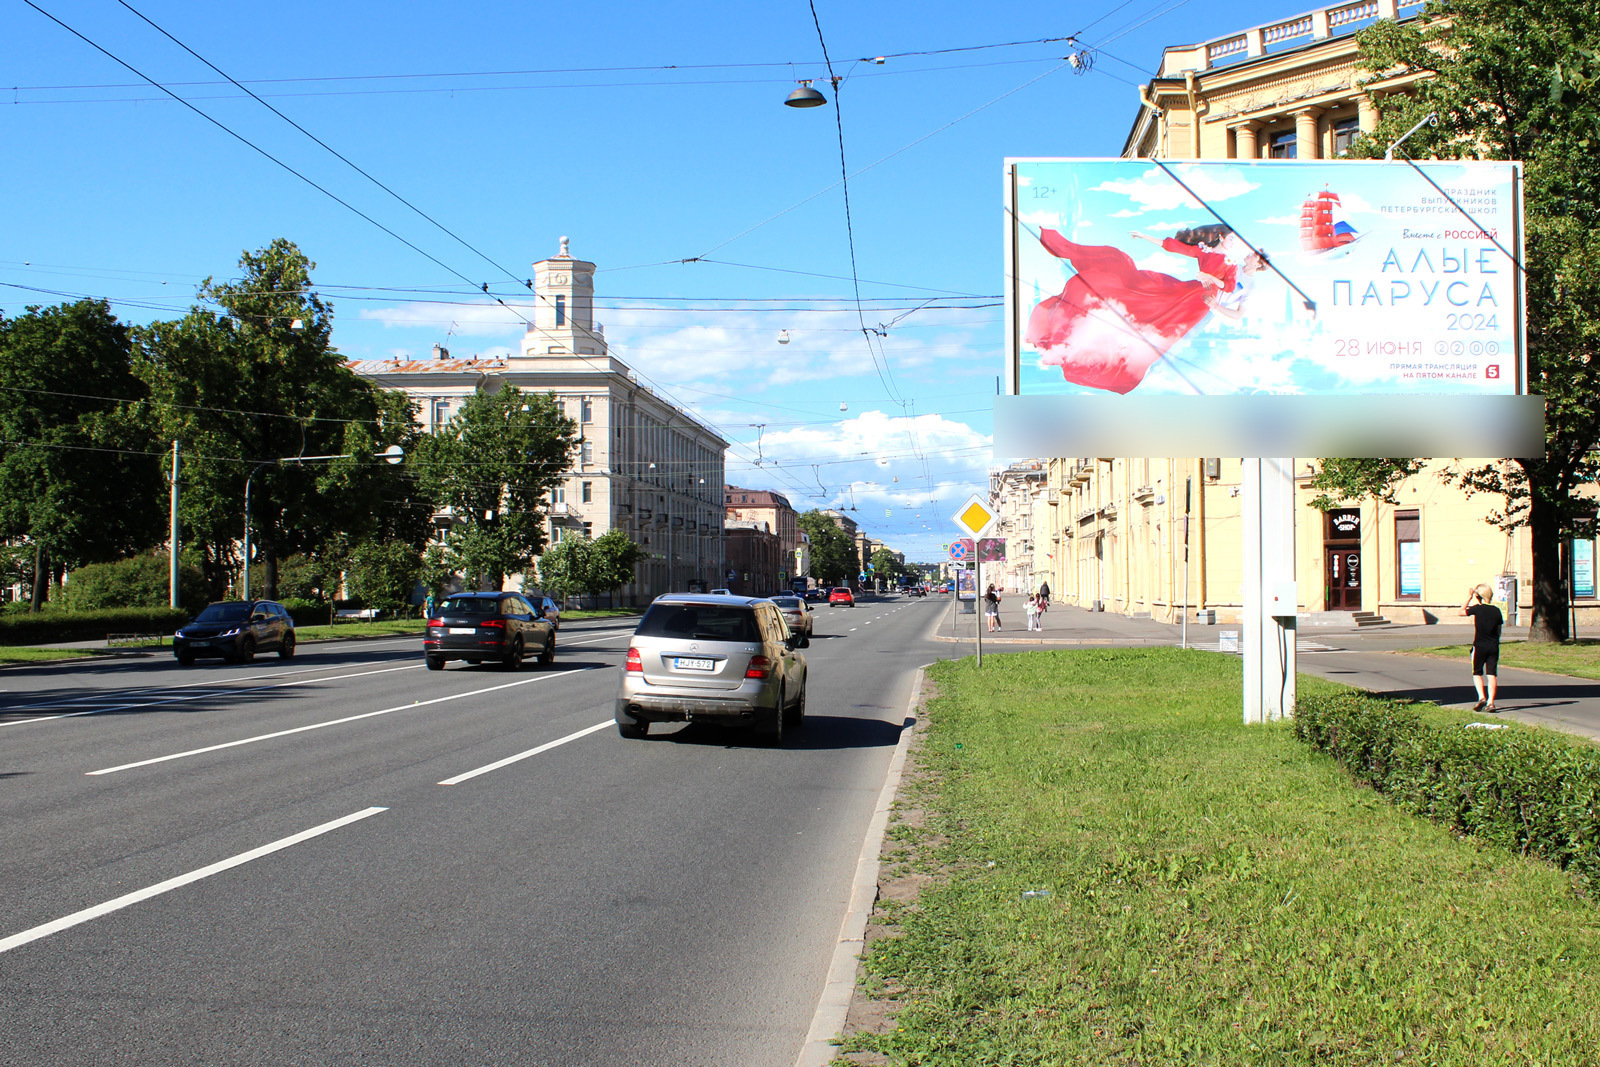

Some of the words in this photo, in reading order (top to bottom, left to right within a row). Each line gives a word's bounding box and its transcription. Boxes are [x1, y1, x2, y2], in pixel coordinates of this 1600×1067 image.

[1032, 186, 1057, 199] 12+
[1444, 188, 1497, 196] ПРАЗДНИК
[1421, 197, 1497, 205] ВЫПУКНИКОВ
[1403, 228, 1434, 239] Вместе
[1444, 228, 1498, 240] РОССИЕЙ
[1382, 247, 1498, 274] АЛЫЕ
[1333, 280, 1498, 306] ПАРУСА
[1446, 313, 1498, 331] 2024
[1334, 338, 1360, 357] 28
[1366, 341, 1422, 355] ИЮНЯ
[1425, 363, 1478, 371] ТРАНСЛЯЦИЯ
[1333, 514, 1360, 526] BARBER
